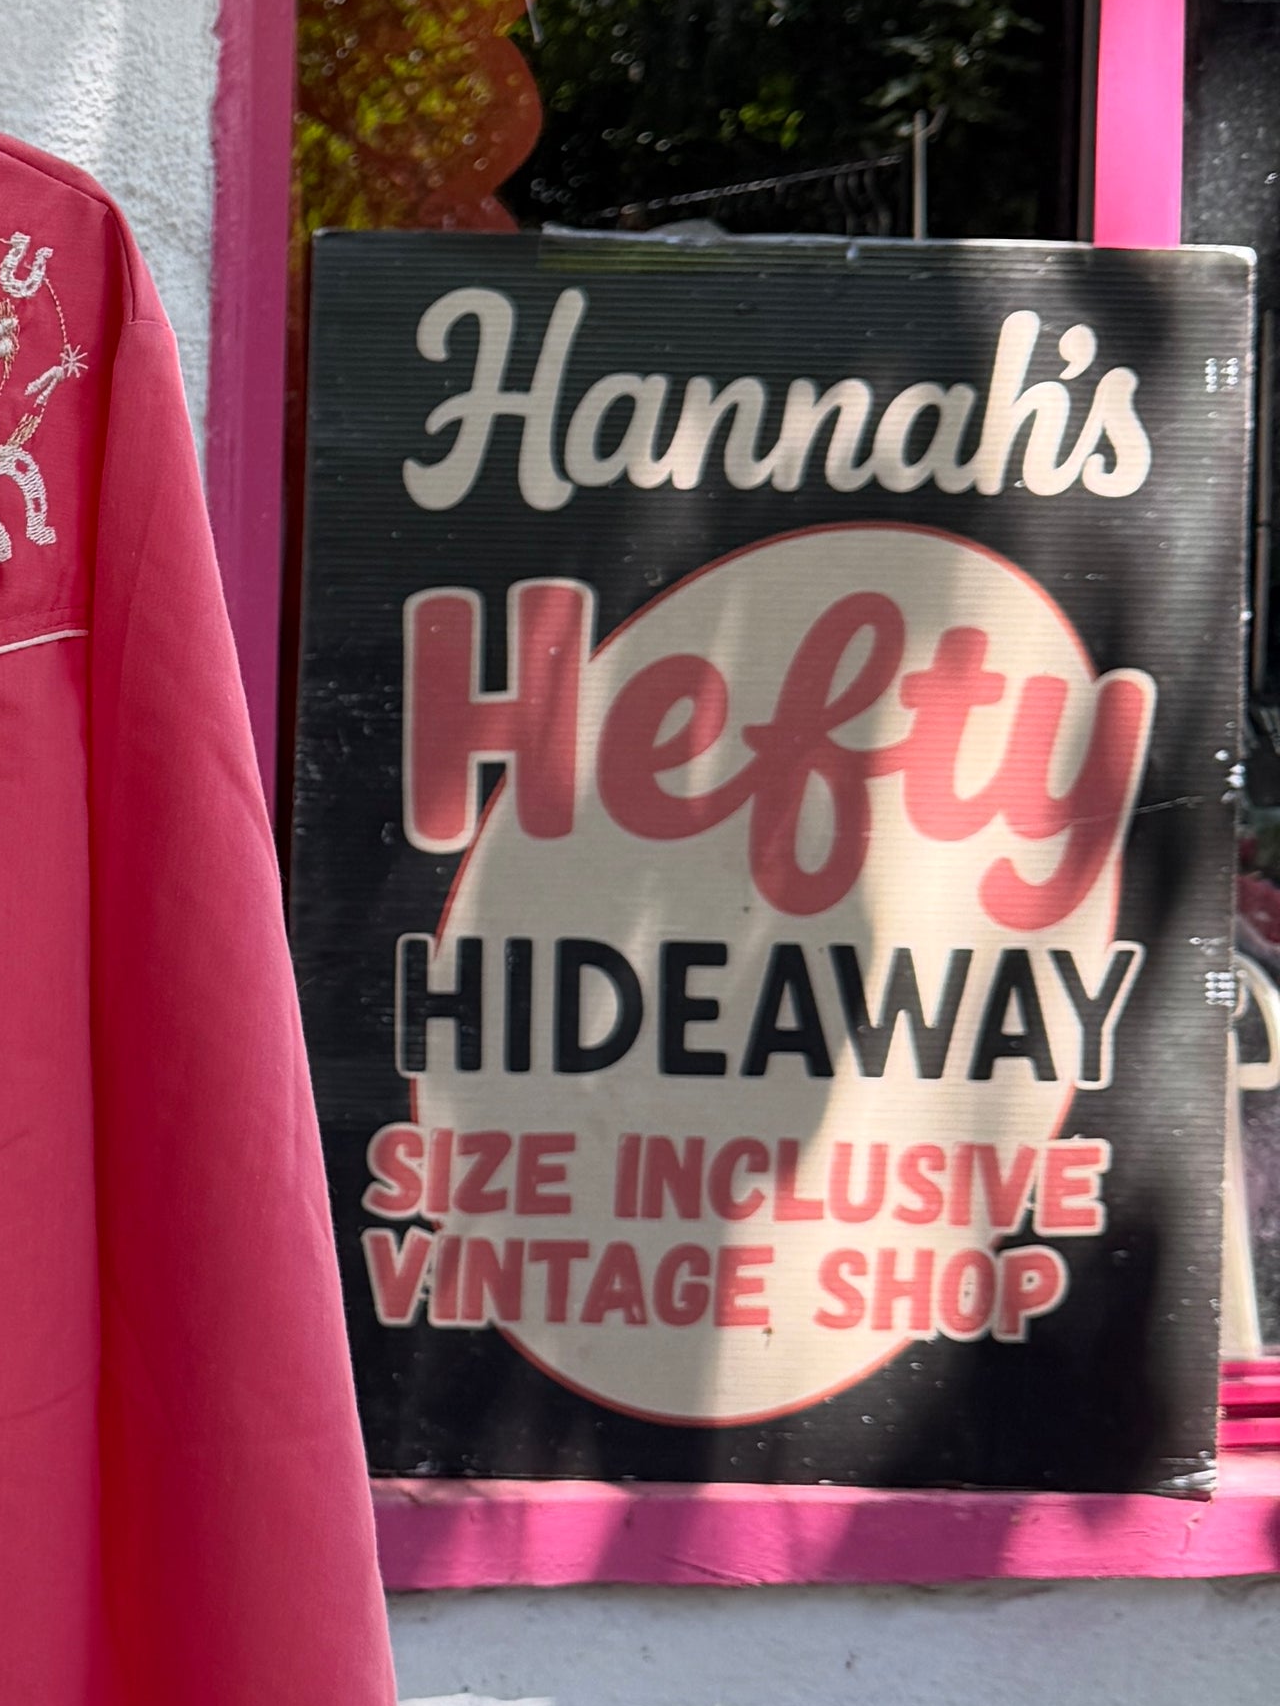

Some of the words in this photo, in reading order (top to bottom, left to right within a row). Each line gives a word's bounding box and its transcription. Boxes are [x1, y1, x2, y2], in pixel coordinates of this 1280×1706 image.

[401, 287, 1153, 512] Hannah's
[405, 579, 1155, 933] Hefty
[400, 936, 1142, 1087] HIDEAWAY
[365, 1125, 576, 1219] SIZE
[614, 1135, 1108, 1233] INCLUSIVE
[365, 1229, 776, 1327] VINTAGE
[813, 1245, 1066, 1339] SHOP
